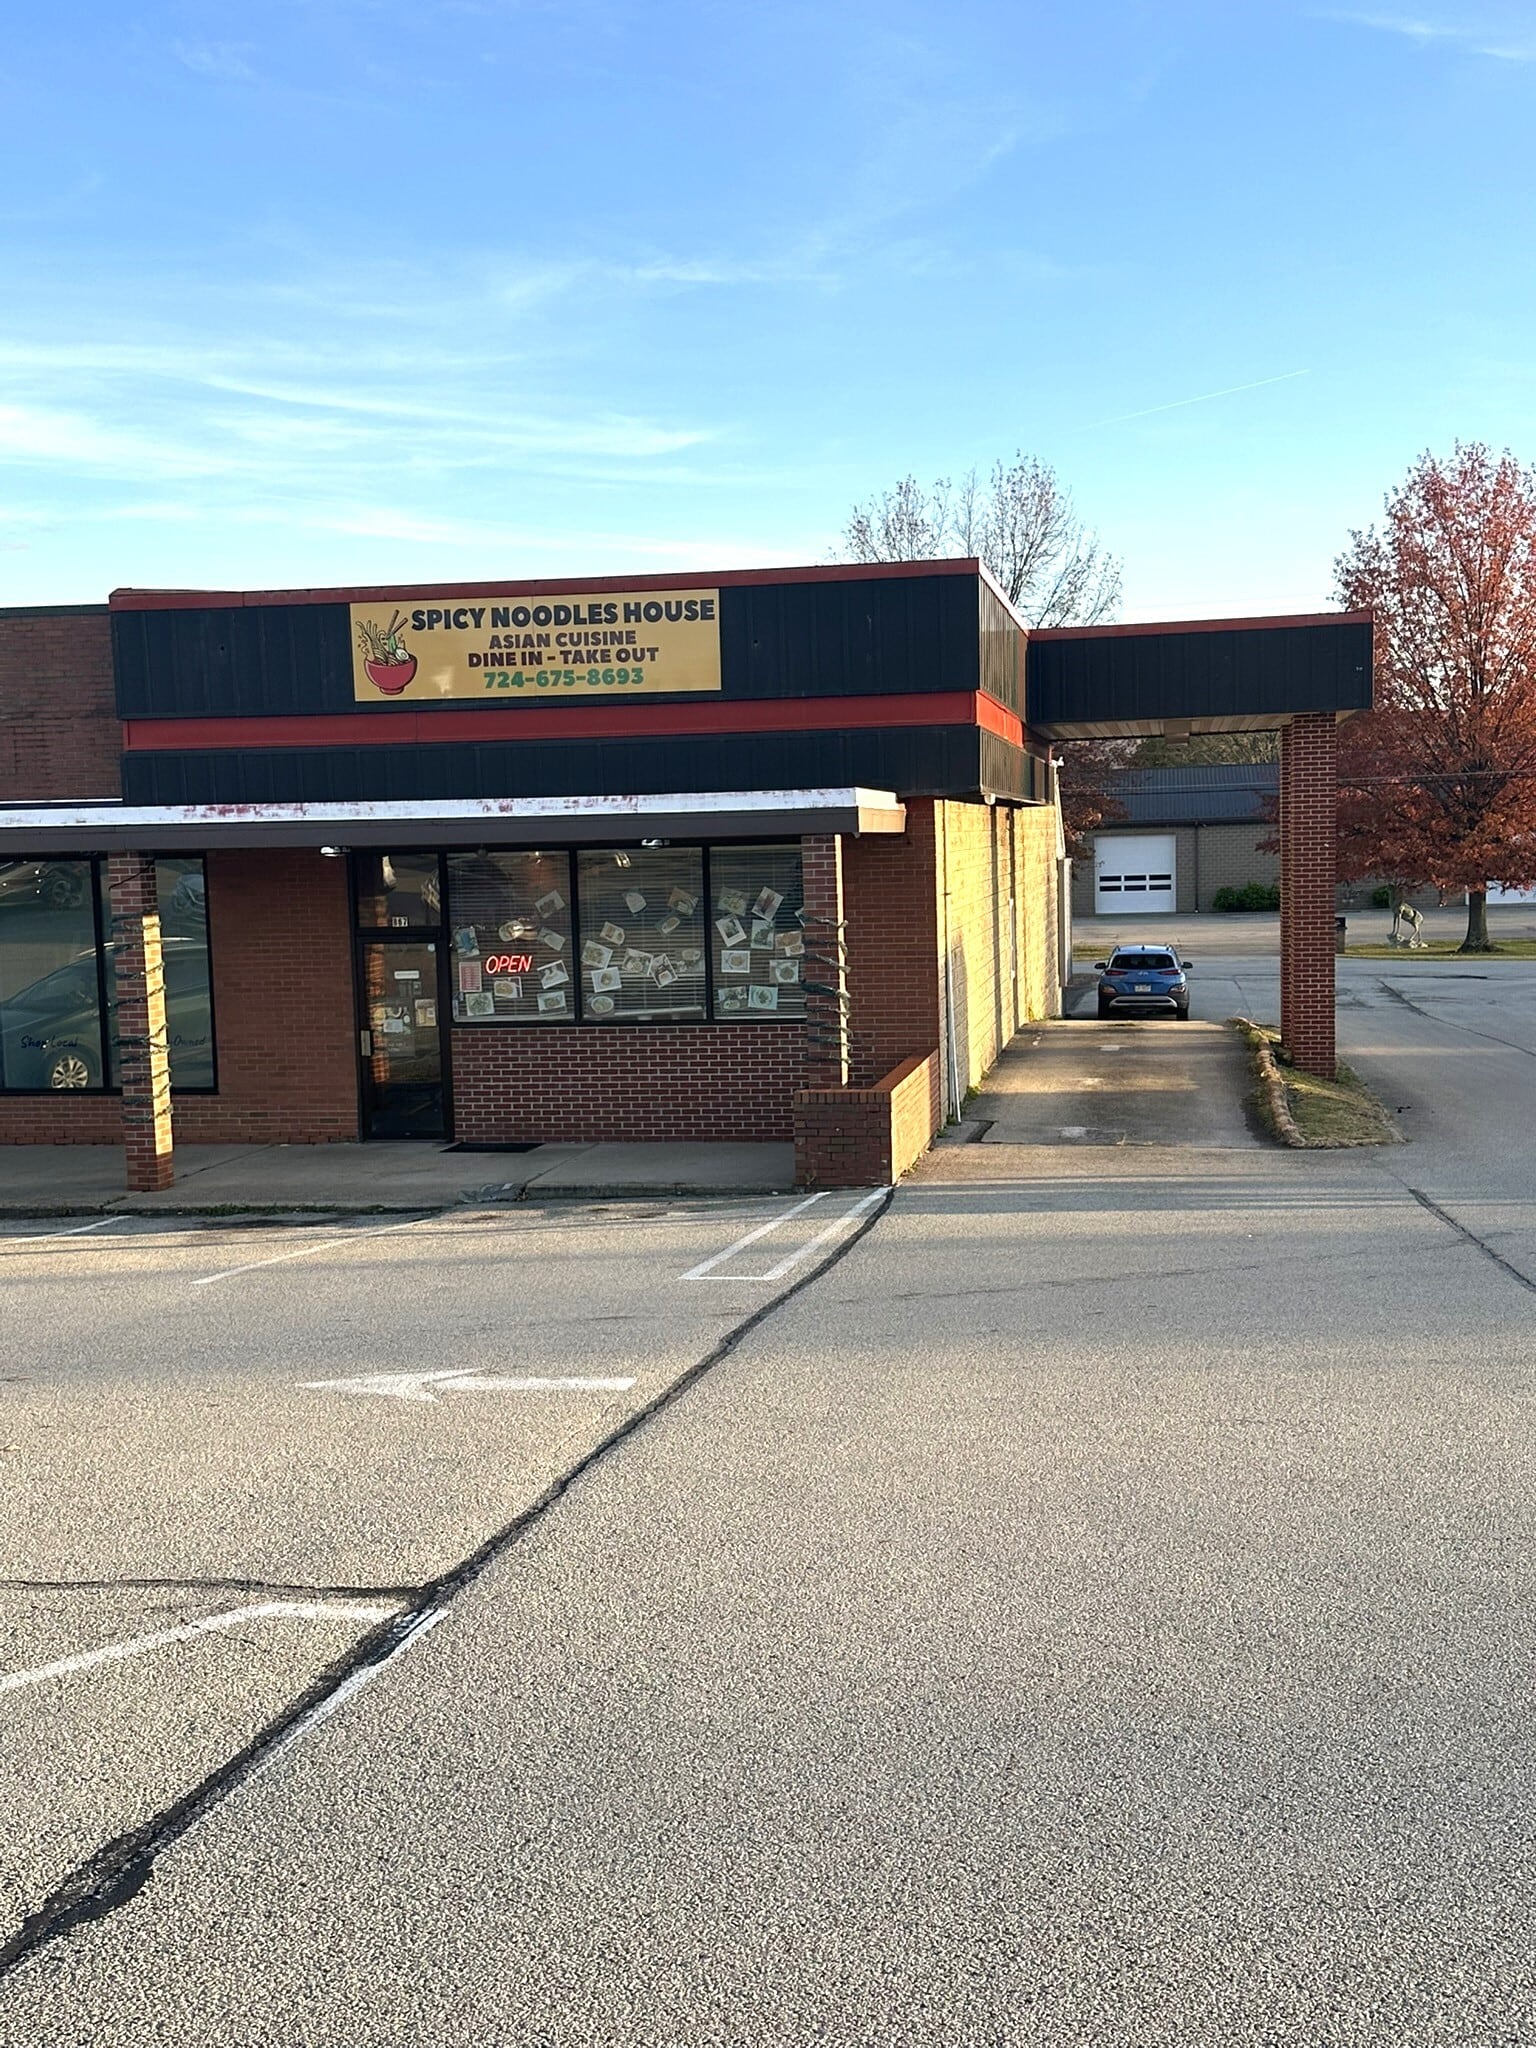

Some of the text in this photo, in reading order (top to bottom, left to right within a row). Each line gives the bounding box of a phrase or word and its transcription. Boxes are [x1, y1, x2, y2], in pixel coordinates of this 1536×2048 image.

[411, 599, 715, 631] SPICY NOODLES HOUSE
[489, 630, 637, 649] ASIAN CUISINE
[468, 652, 517, 668] DINE
[521, 650, 543, 666] IN
[560, 649, 611, 665] TAKE
[615, 647, 659, 663] OUT
[483, 667, 644, 689] 724-675-8693
[485, 955, 533, 974] OPEN
[51, 1035, 78, 1048] Local
